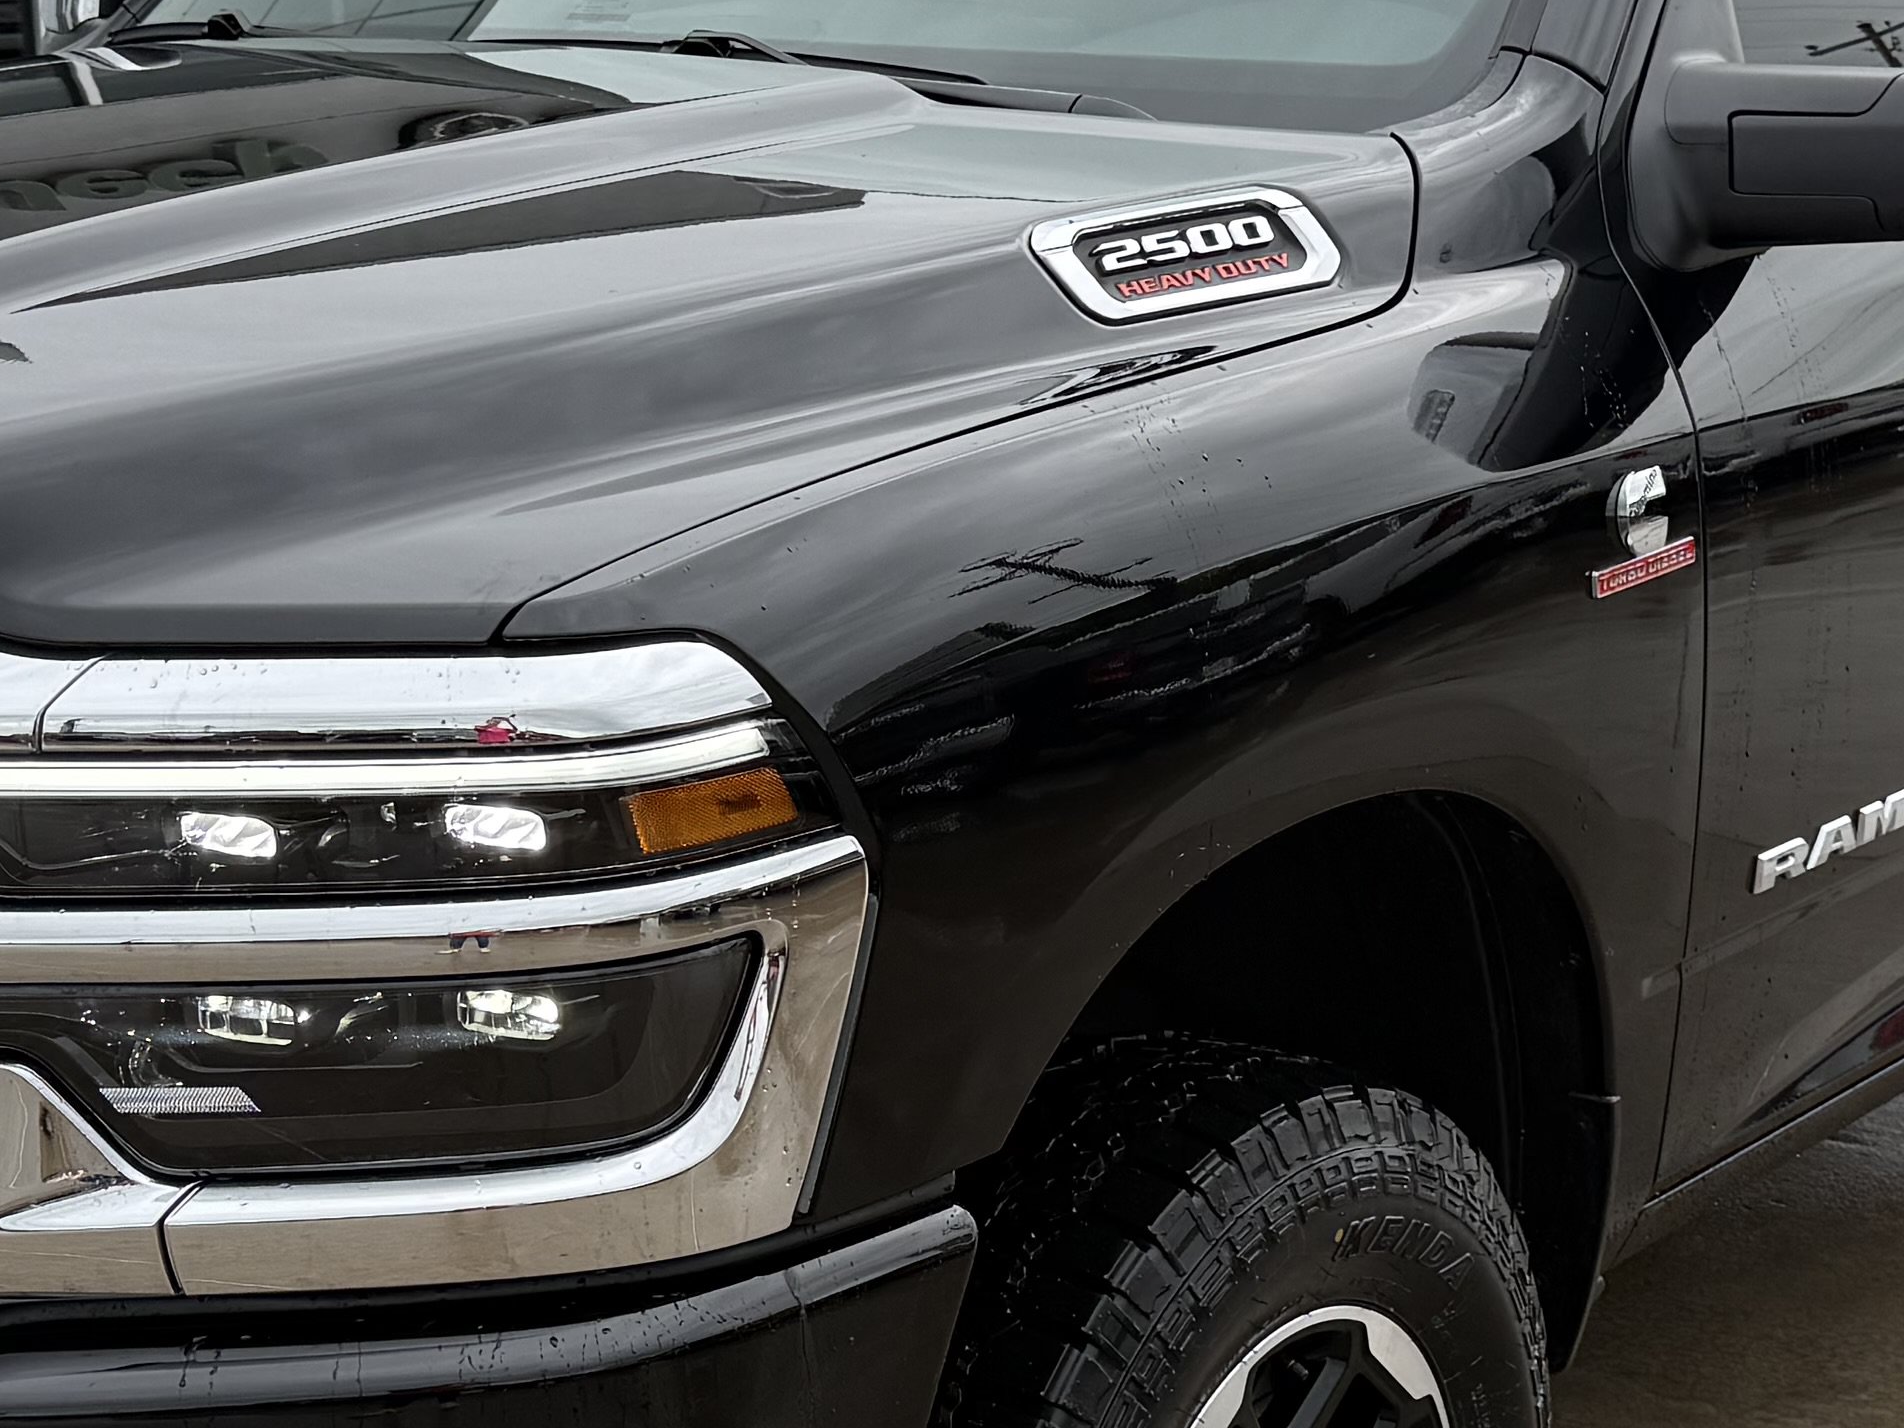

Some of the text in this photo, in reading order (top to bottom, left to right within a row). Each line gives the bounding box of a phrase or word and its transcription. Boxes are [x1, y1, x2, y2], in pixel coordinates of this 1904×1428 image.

[1096, 215, 1276, 273] 2500
[1115, 253, 1289, 298] HEAVY DUTY
[1332, 1214, 1476, 1292] KENDA
